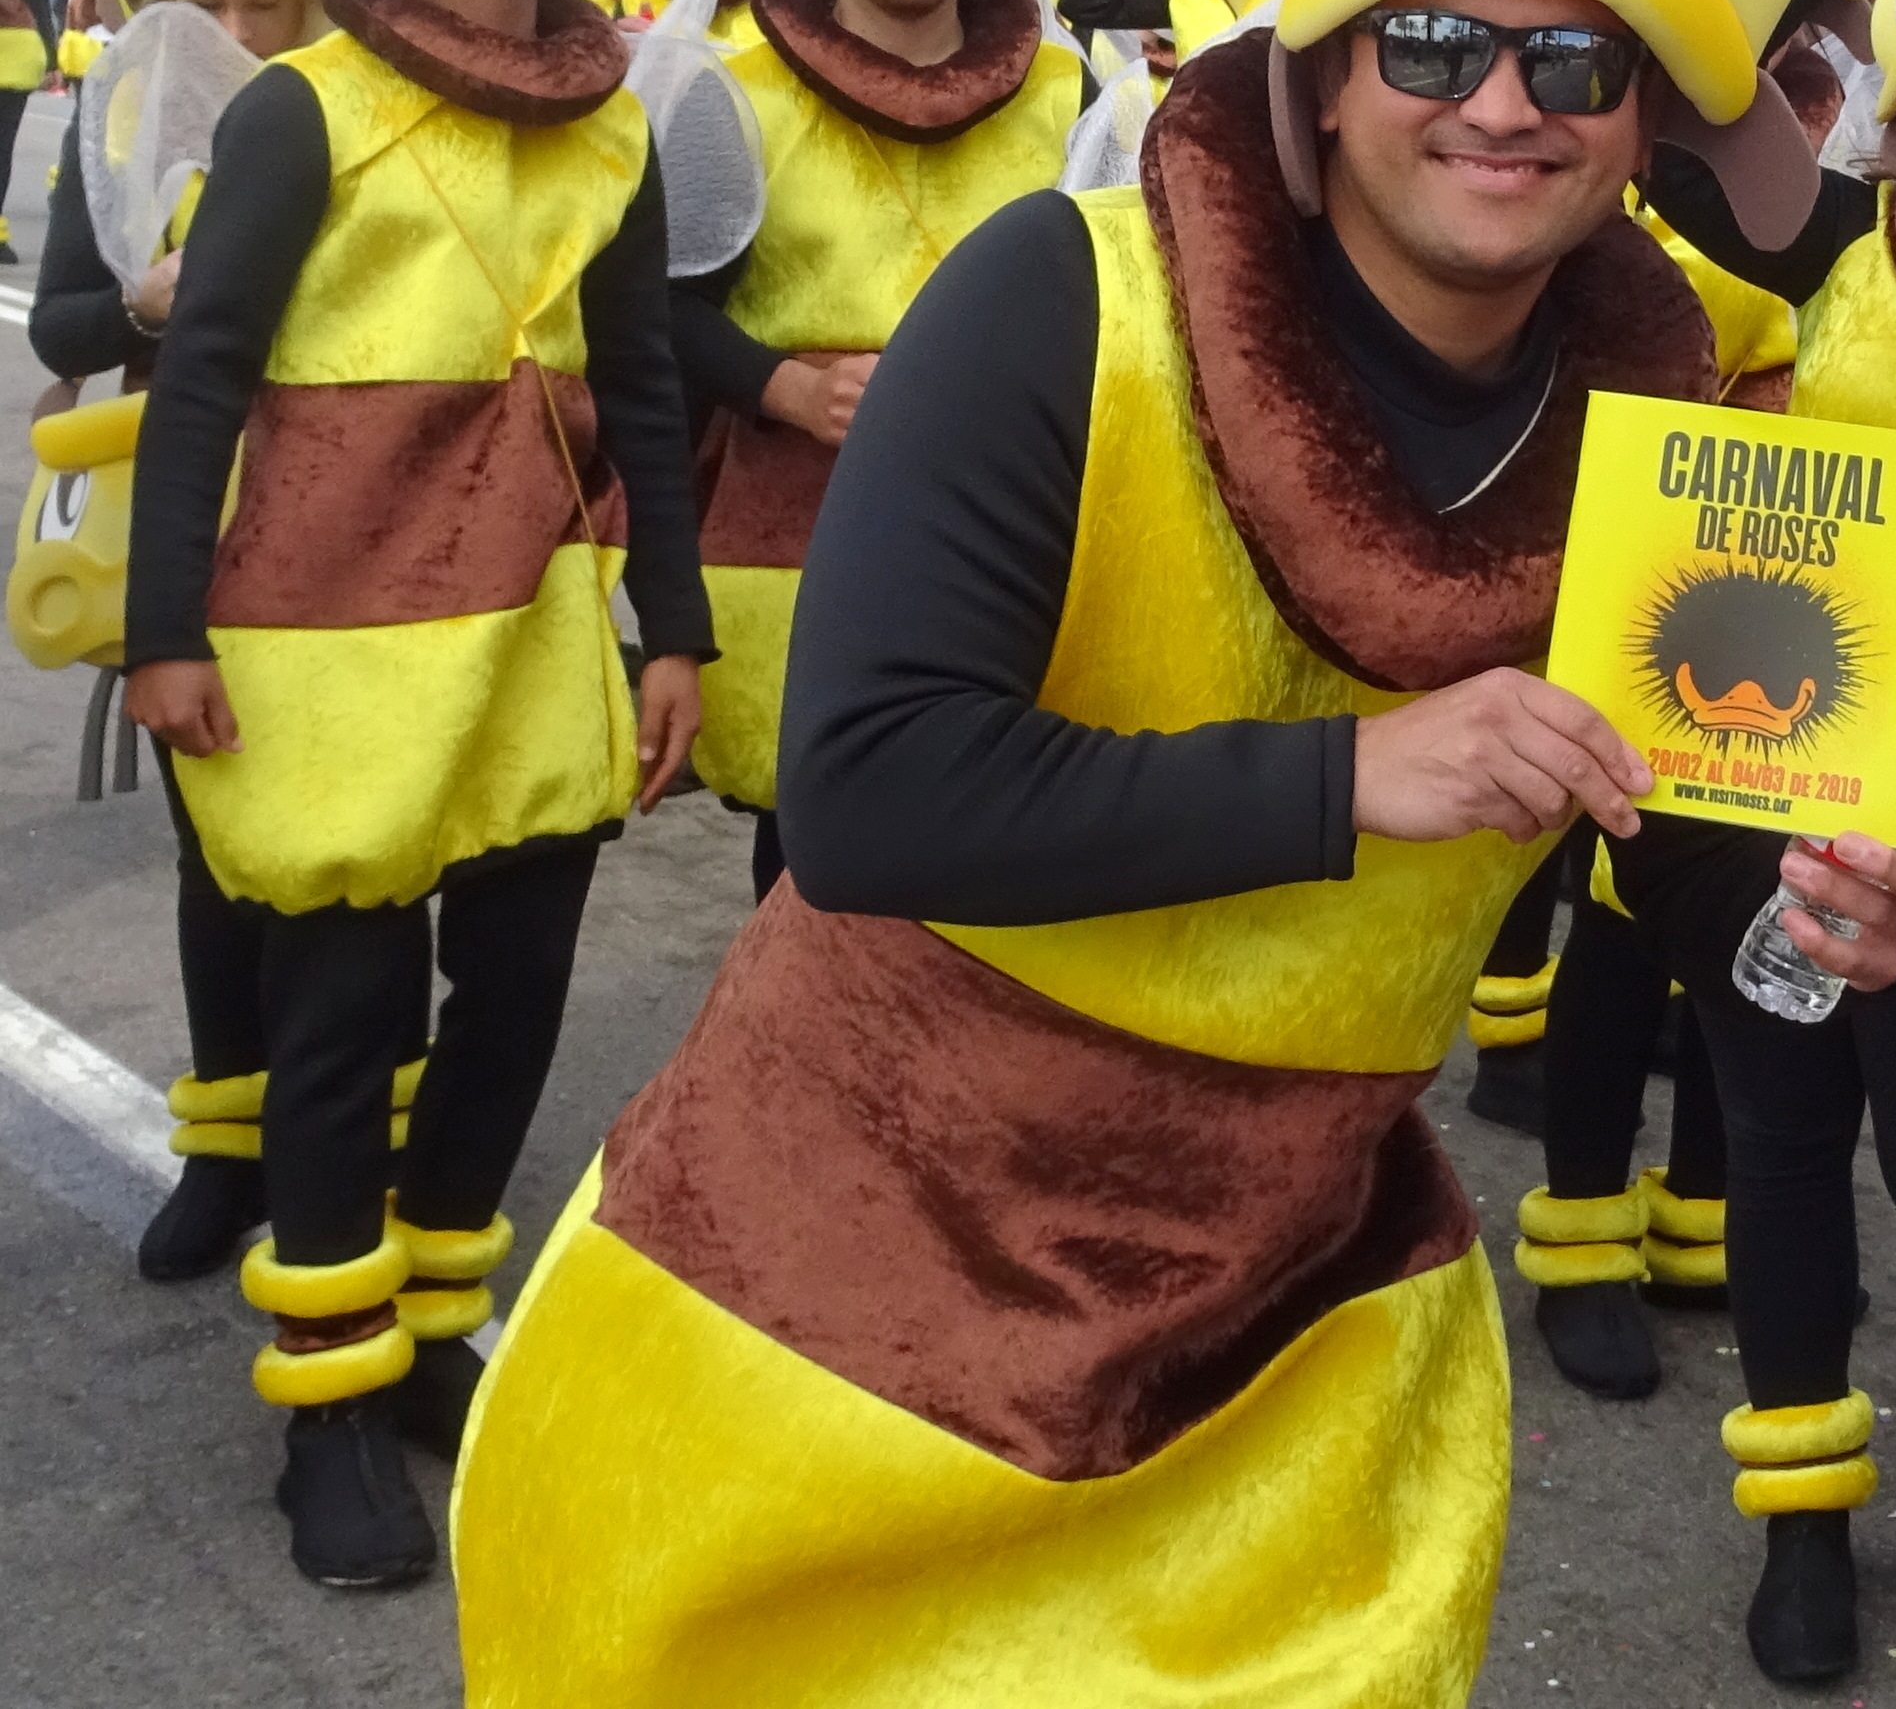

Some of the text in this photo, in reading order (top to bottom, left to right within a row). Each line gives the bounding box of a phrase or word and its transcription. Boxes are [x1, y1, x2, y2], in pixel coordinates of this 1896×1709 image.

[1658, 431, 1886, 525] CARNAVAL
[1695, 504, 1840, 567] DE ROSES
[1674, 783, 1793, 814] WWW.VISITROSES.CAT
[1705, 760, 1725, 785] AL
[1731, 760, 1786, 792] 04/03
[1789, 772, 1812, 797] DE
[1816, 772, 1862, 805] 2019
